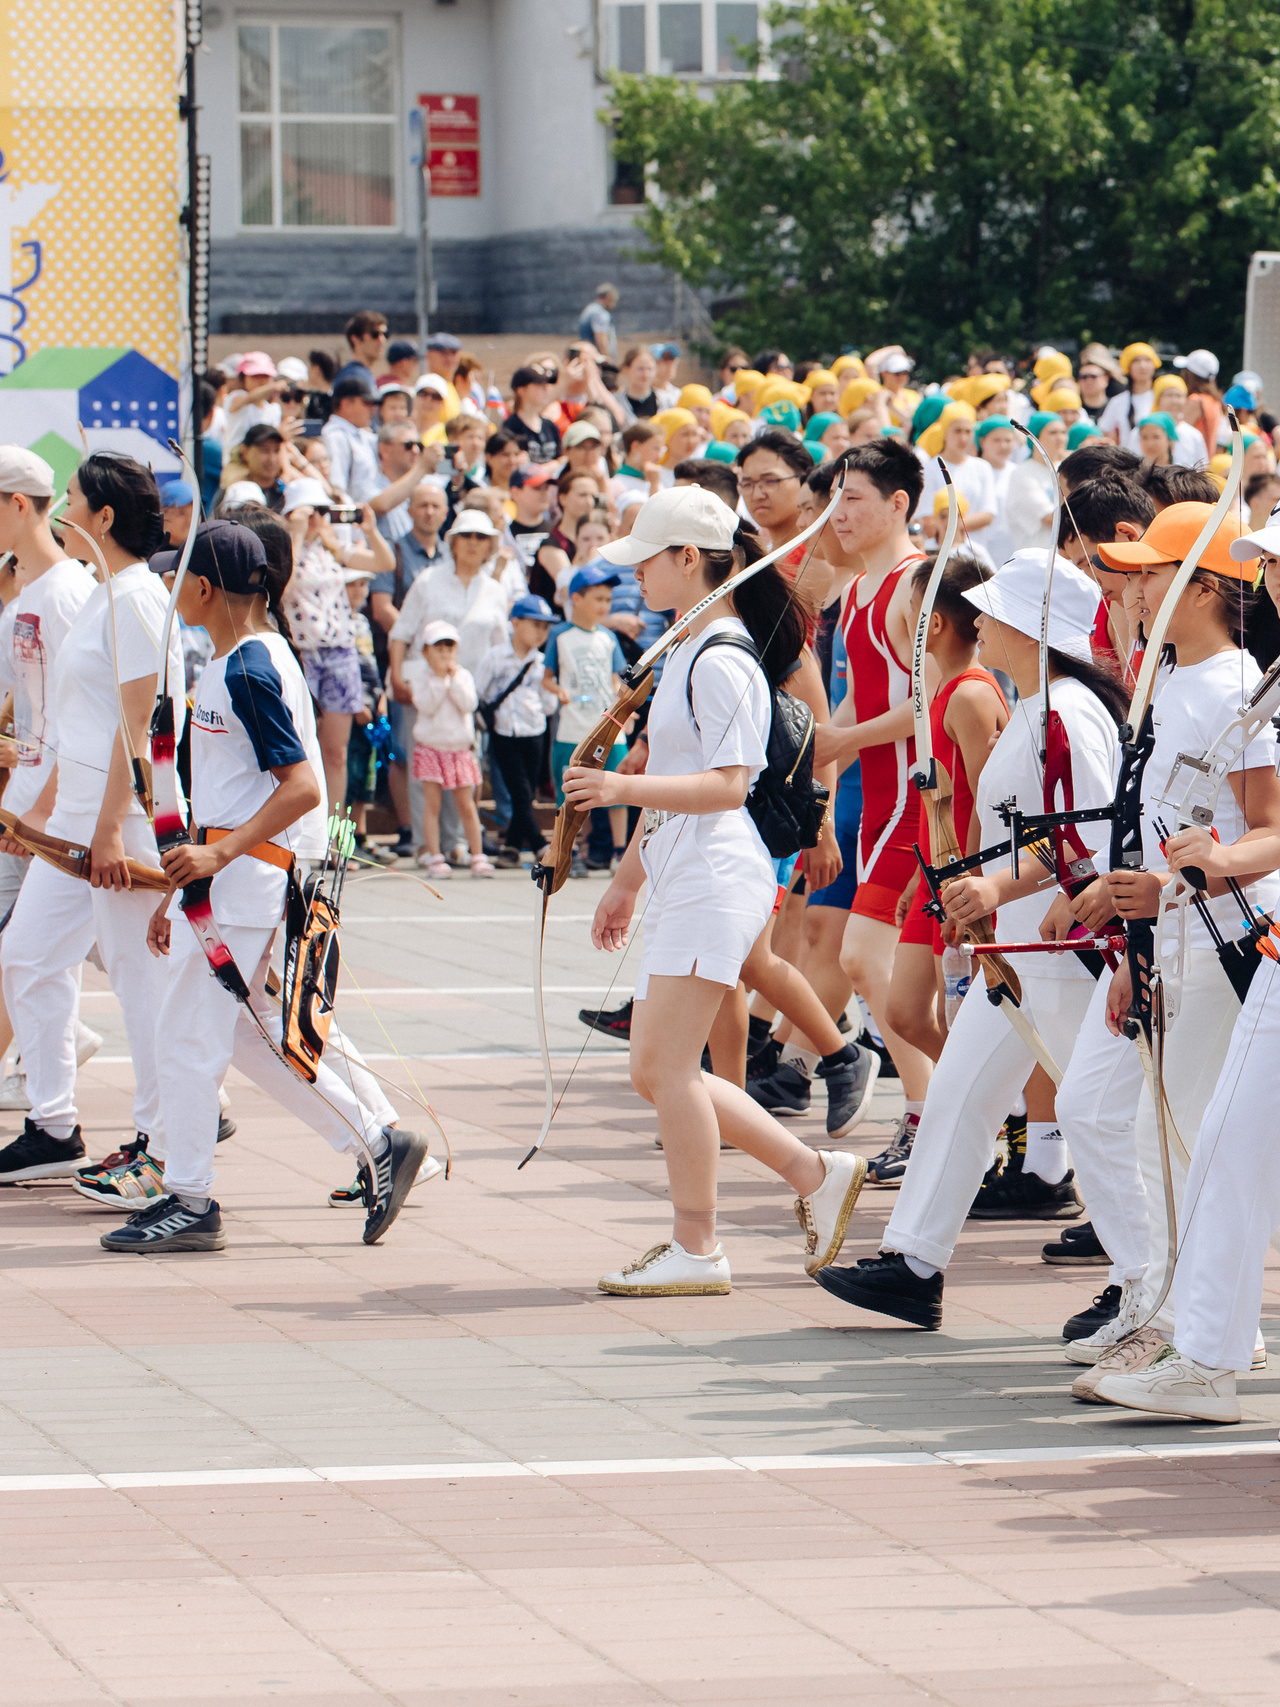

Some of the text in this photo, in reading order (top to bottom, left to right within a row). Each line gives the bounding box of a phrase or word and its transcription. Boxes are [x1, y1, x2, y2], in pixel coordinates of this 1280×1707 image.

[672, 580, 737, 632] SAMICK
[914, 611, 927, 713] KAP ARCHERY
